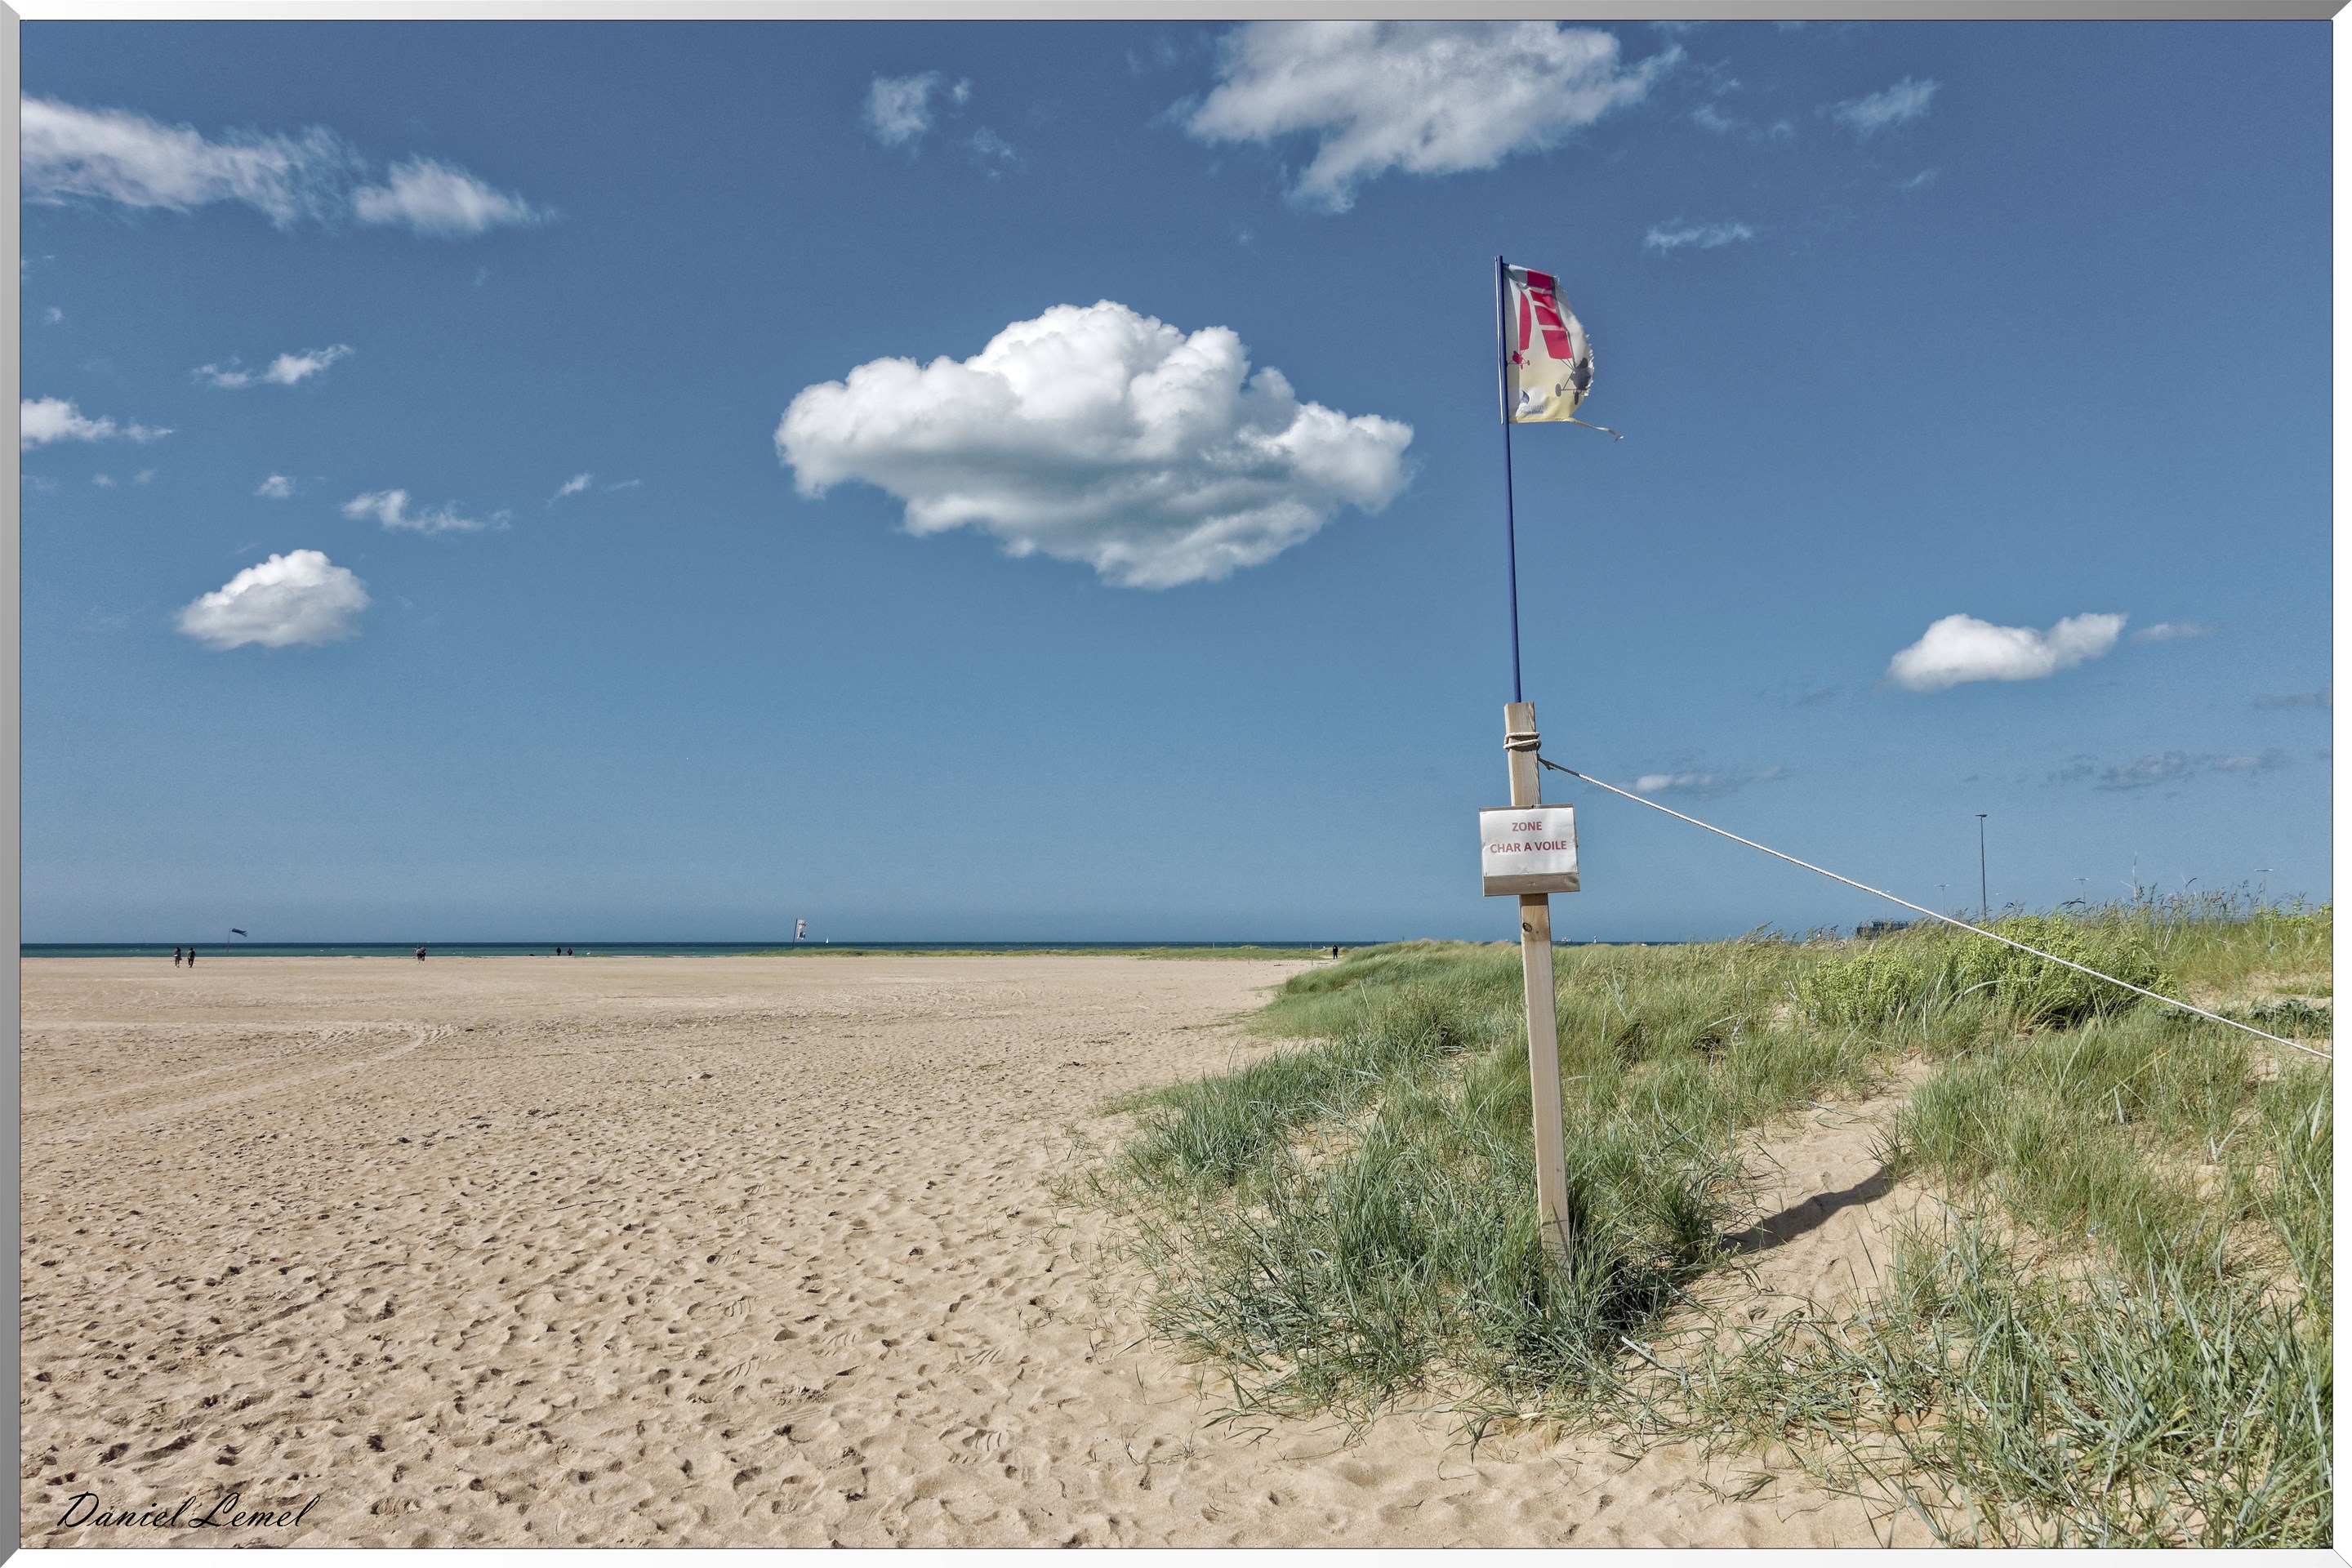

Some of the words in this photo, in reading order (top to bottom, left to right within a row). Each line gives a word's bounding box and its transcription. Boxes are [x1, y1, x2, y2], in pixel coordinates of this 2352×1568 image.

[1512, 822, 1543, 831] ZONE
[1490, 843, 1521, 853] CHAR
[1524, 842, 1532, 851] A
[1535, 840, 1567, 851] VOILE
